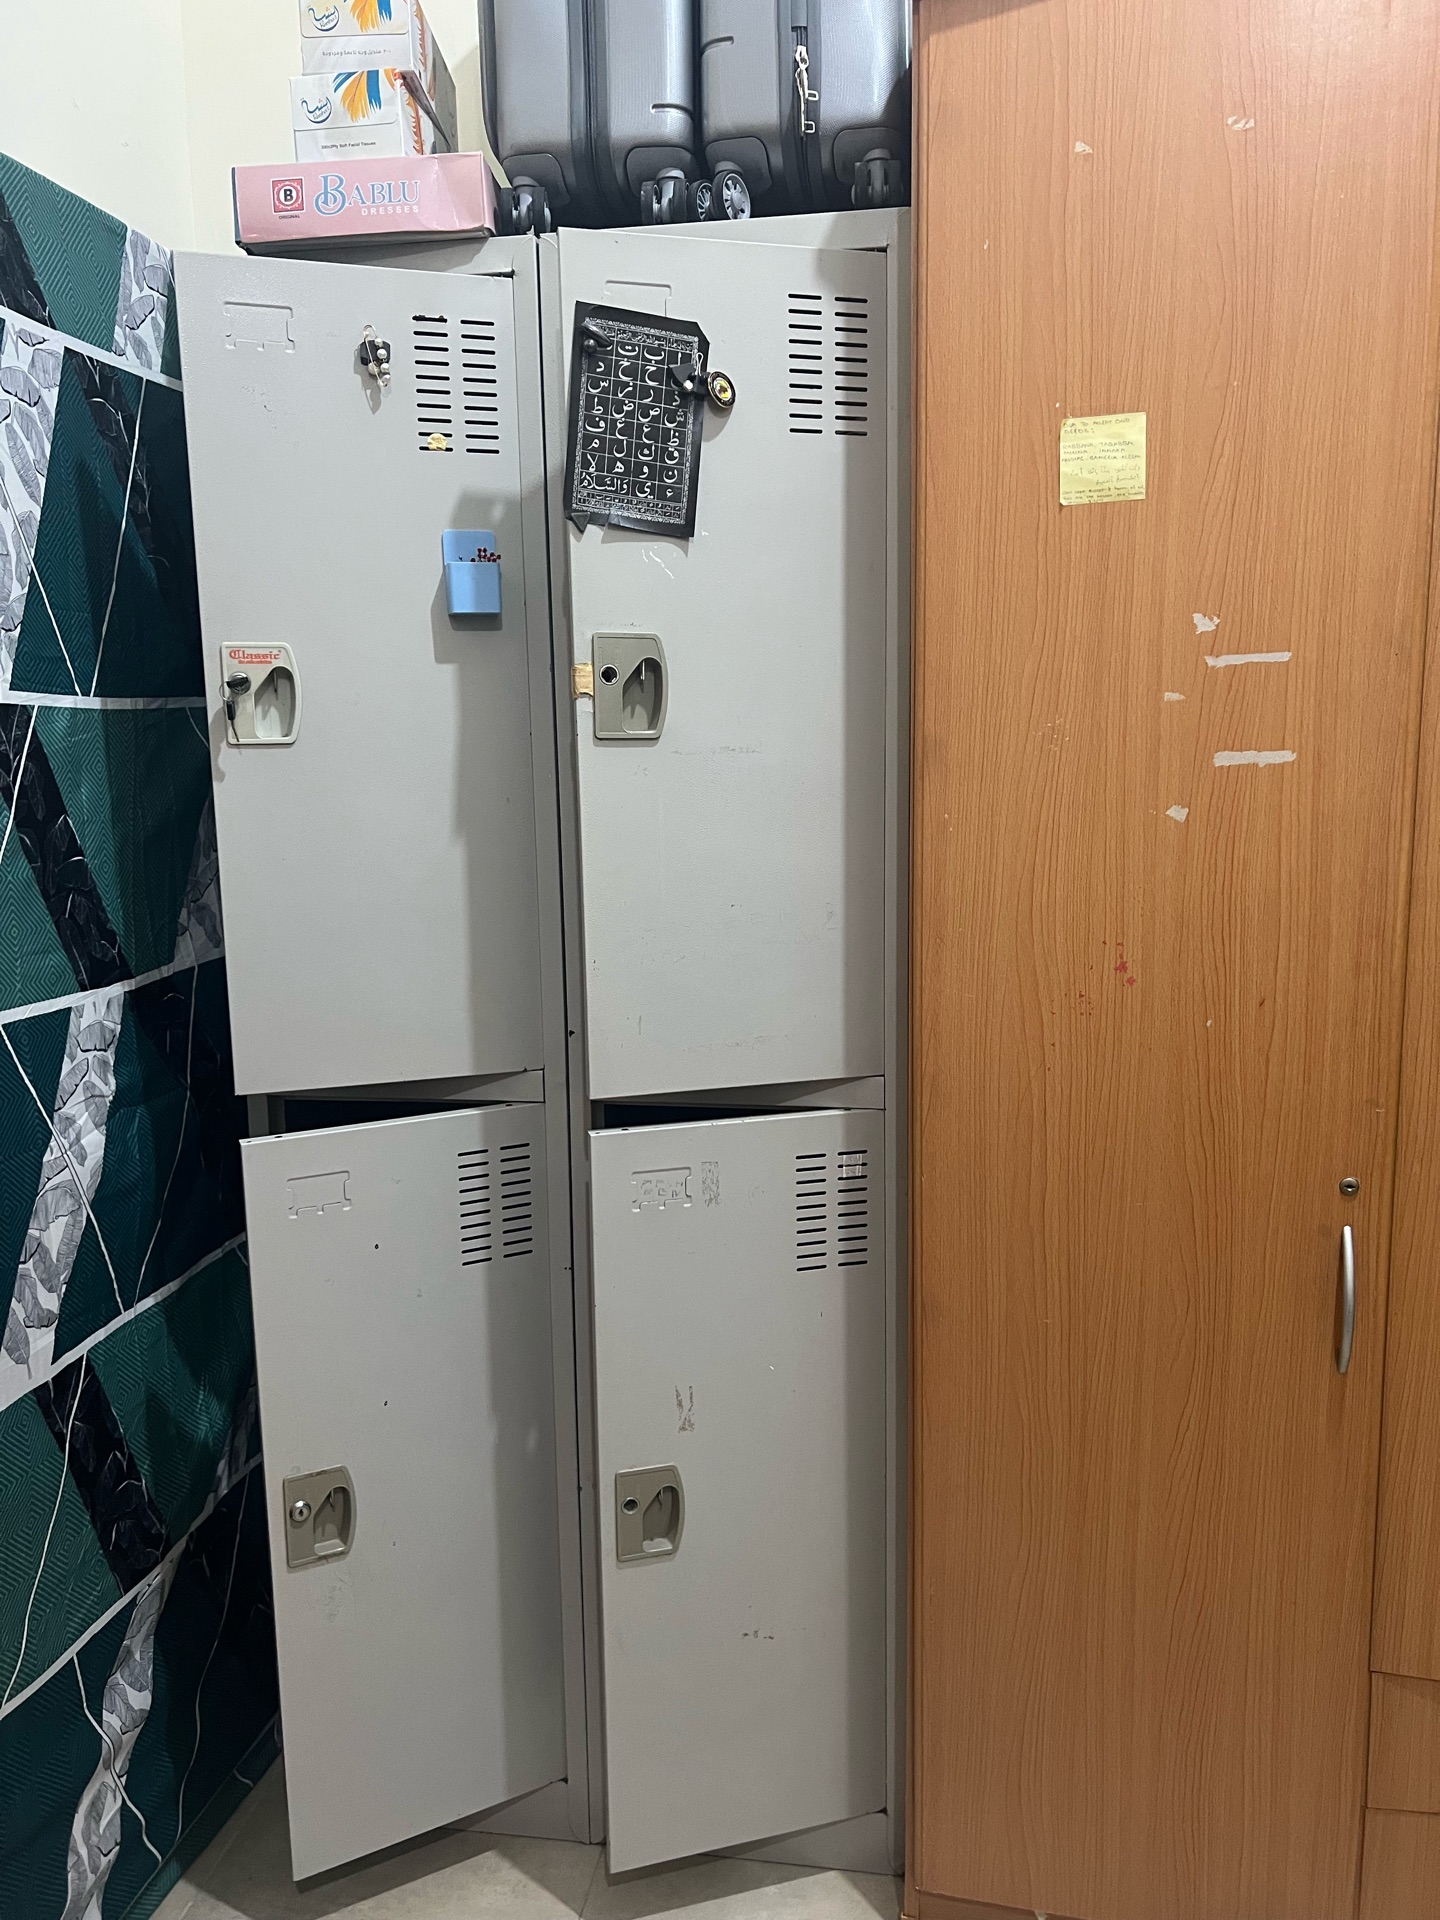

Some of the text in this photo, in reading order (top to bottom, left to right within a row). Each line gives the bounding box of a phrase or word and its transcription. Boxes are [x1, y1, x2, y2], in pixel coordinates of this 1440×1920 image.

[283, 188, 294, 202] B
[314, 174, 420, 216] BABLU
[361, 205, 420, 216] DRESSES
[617, 343, 639, 356] ت
[643, 347, 665, 364] ب
[596, 361, 605, 372] د
[587, 379, 609, 392] س
[591, 396, 685, 427] ش ص ض ط
[585, 417, 680, 446] ظ ع غ ف
[586, 439, 680, 464] ق ك ل م
[639, 465, 649, 478] و
[663, 469, 678, 483] ن
[635, 482, 654, 498] ي
[228, 649, 281, 660] Classic
